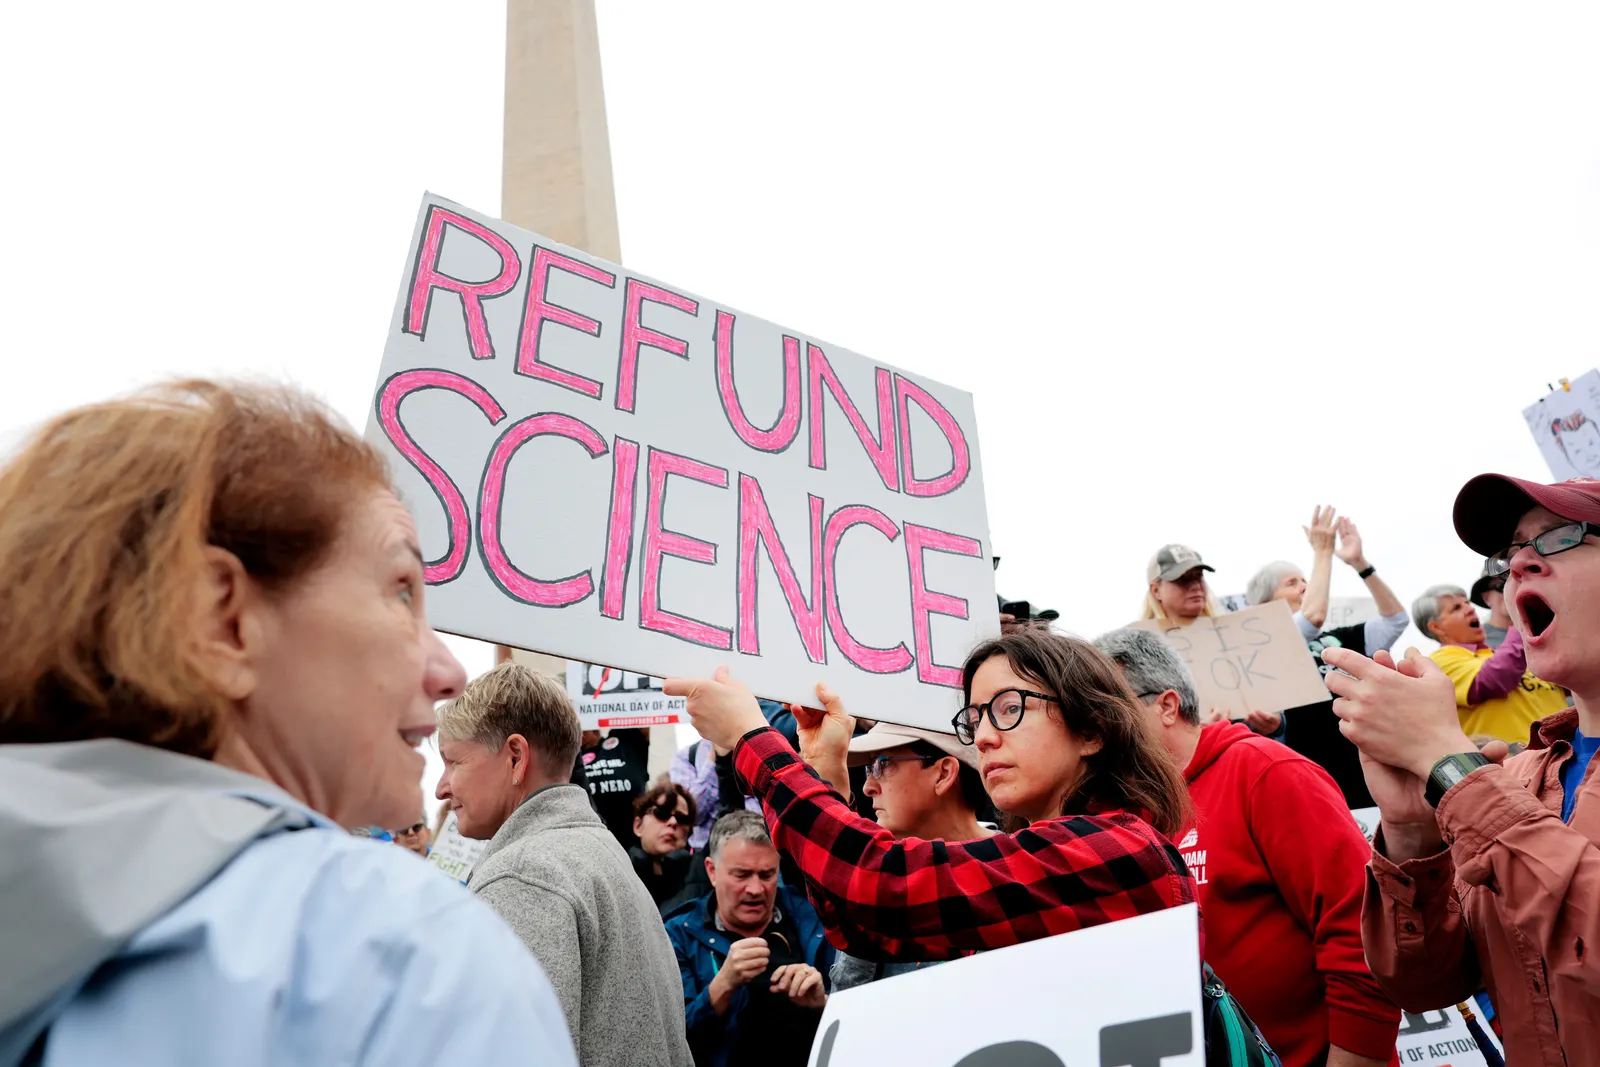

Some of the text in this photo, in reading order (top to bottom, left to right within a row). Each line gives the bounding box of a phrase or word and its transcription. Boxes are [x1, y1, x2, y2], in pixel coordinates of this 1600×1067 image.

[402, 204, 971, 497] REFUND
[375, 367, 984, 689] SCIENCE
[1206, 616, 1272, 653] IS
[1209, 649, 1278, 691] OK
[580, 699, 685, 714] NATIONAL DAY OF ACT
[599, 779, 632, 794] NERO
[429, 852, 467, 877] FIGHT
[1406, 1046, 1425, 1063] OF
[1427, 1036, 1478, 1059] ACTION
